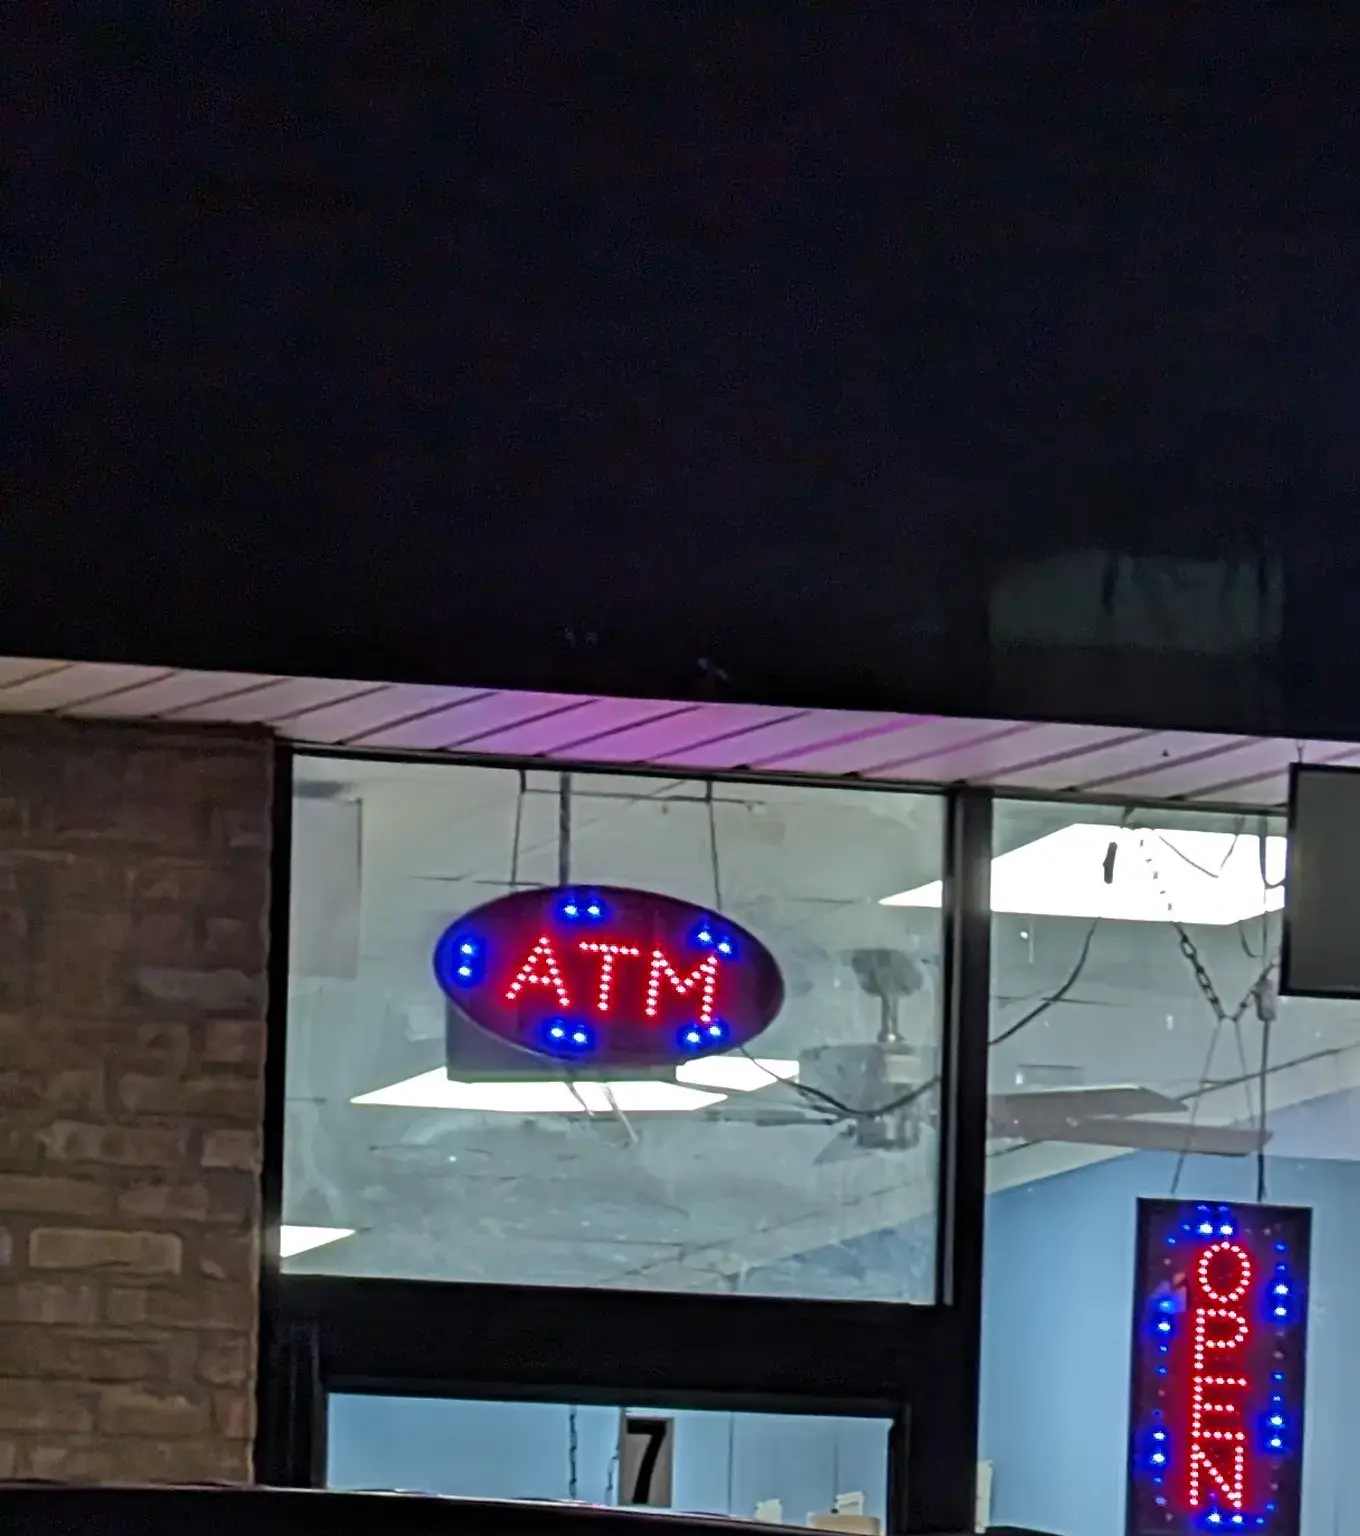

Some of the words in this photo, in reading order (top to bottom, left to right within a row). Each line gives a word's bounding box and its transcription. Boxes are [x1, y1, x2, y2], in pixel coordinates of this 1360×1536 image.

[503, 932, 722, 1024] ATM
[1188, 1239, 1251, 1508] OPEN
[626, 1418, 668, 1506] 7
